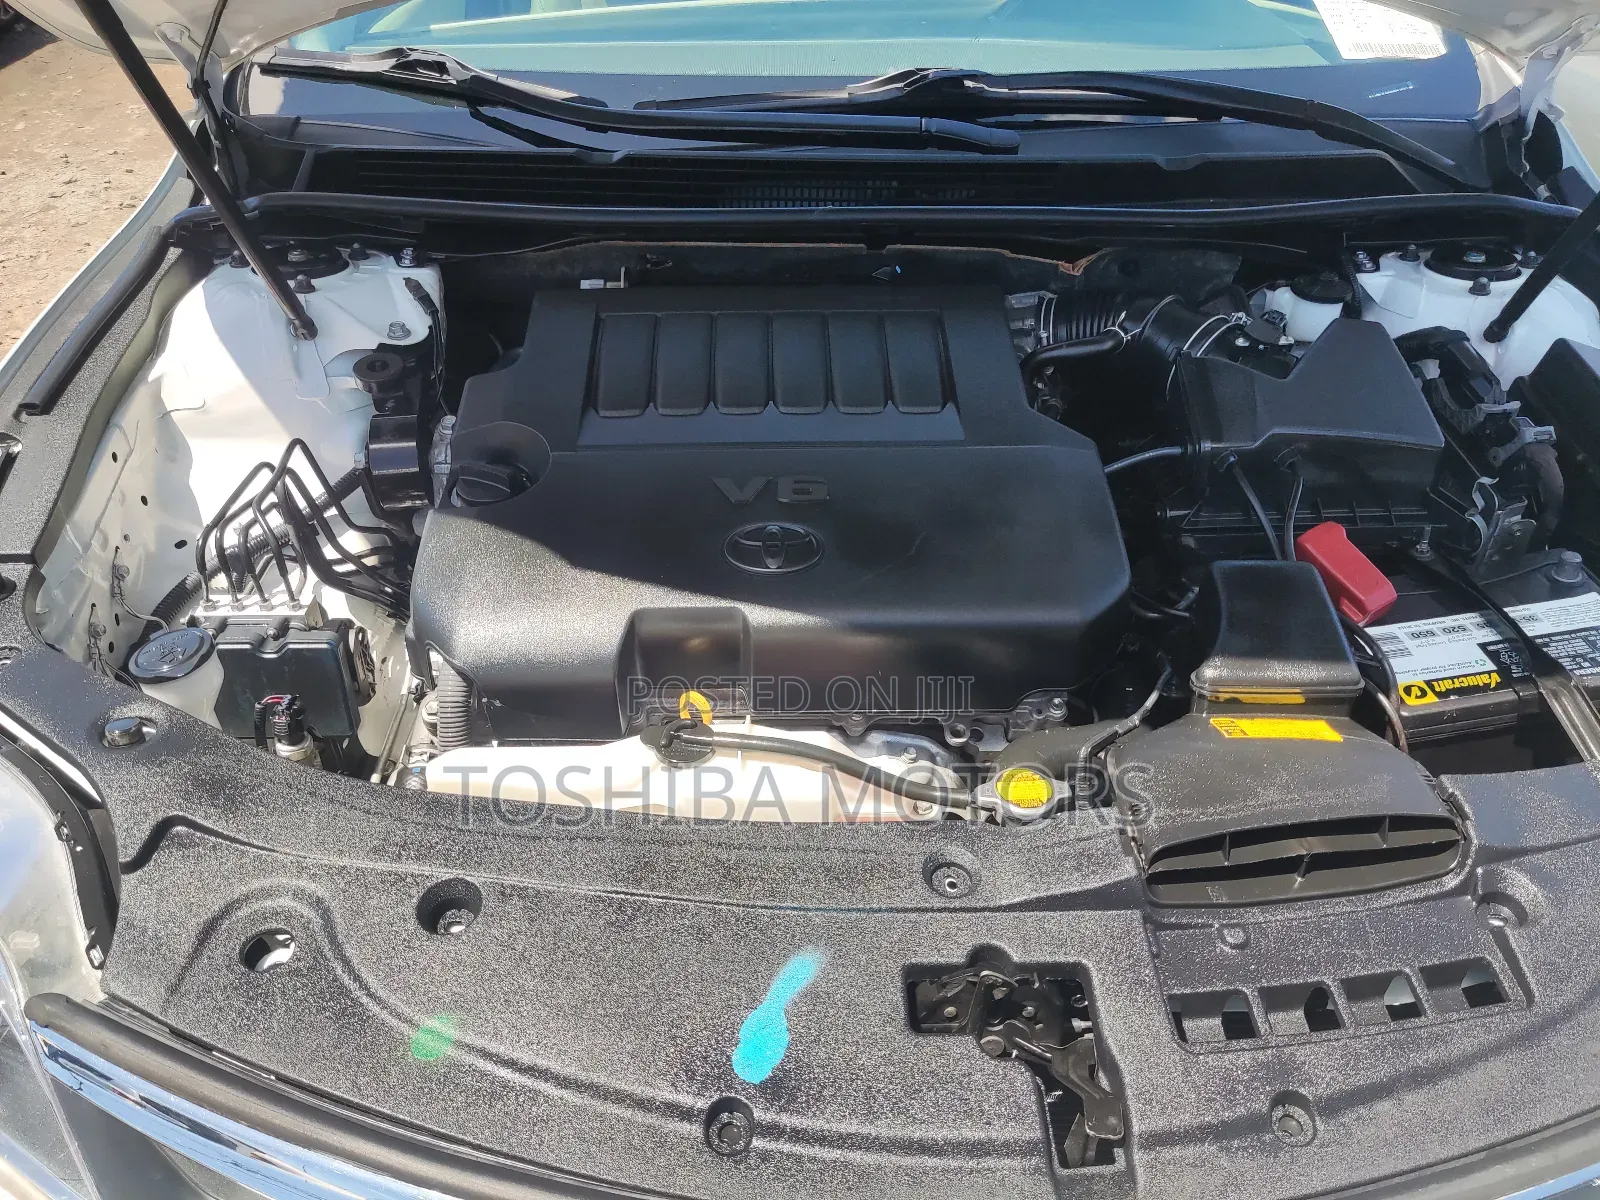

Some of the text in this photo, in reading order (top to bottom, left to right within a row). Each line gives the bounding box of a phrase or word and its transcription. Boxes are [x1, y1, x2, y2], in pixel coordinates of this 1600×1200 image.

[709, 476, 829, 503] V6
[1411, 630, 1436, 639] 650
[1442, 625, 1467, 634] 520
[1431, 672, 1501, 692] Valucraft
